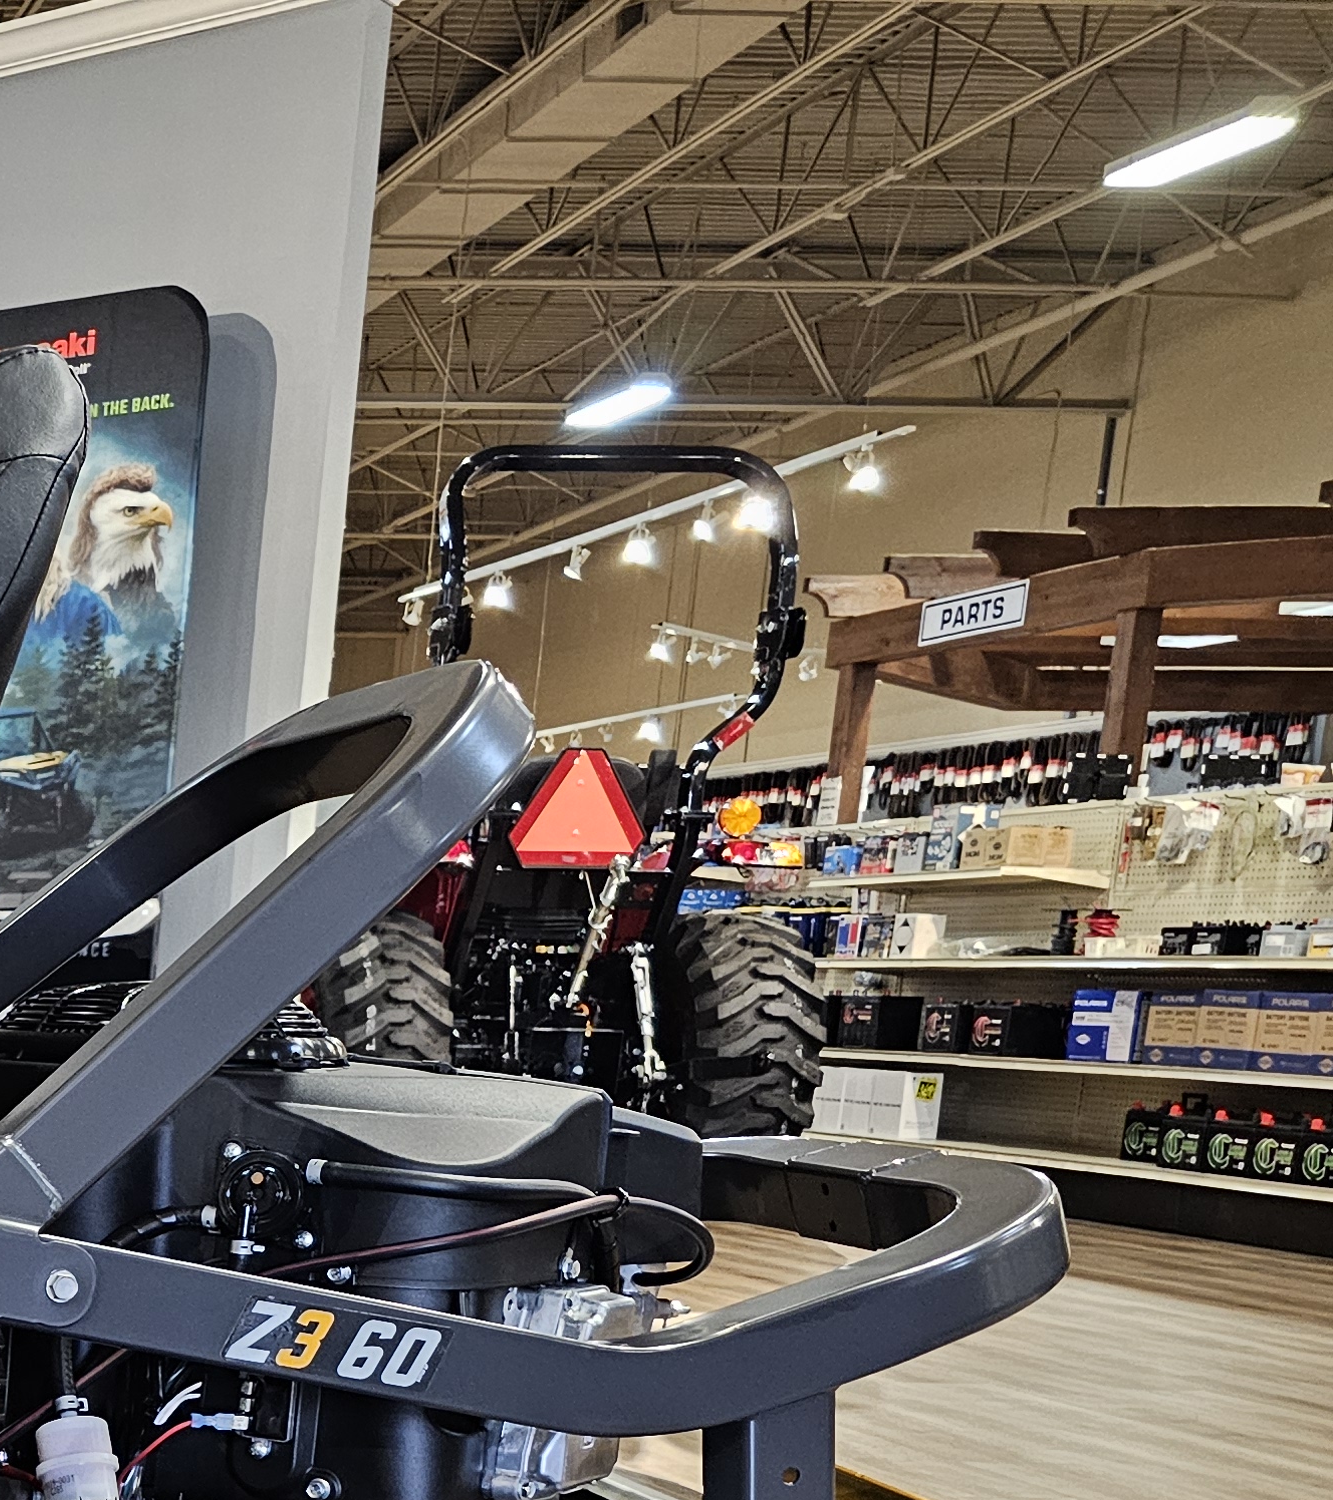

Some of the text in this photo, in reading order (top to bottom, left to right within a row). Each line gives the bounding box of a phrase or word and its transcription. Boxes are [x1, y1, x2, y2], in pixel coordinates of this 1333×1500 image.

[102, 399, 129, 417] THE
[131, 393, 175, 413] BACK.
[940, 596, 1005, 631] PARTS
[1160, 994, 1196, 1004] POLARIS
[1212, 994, 1248, 1004] POLARIS
[1271, 997, 1310, 1008] POLARIS
[224, 1299, 443, 1388] Z3 60
